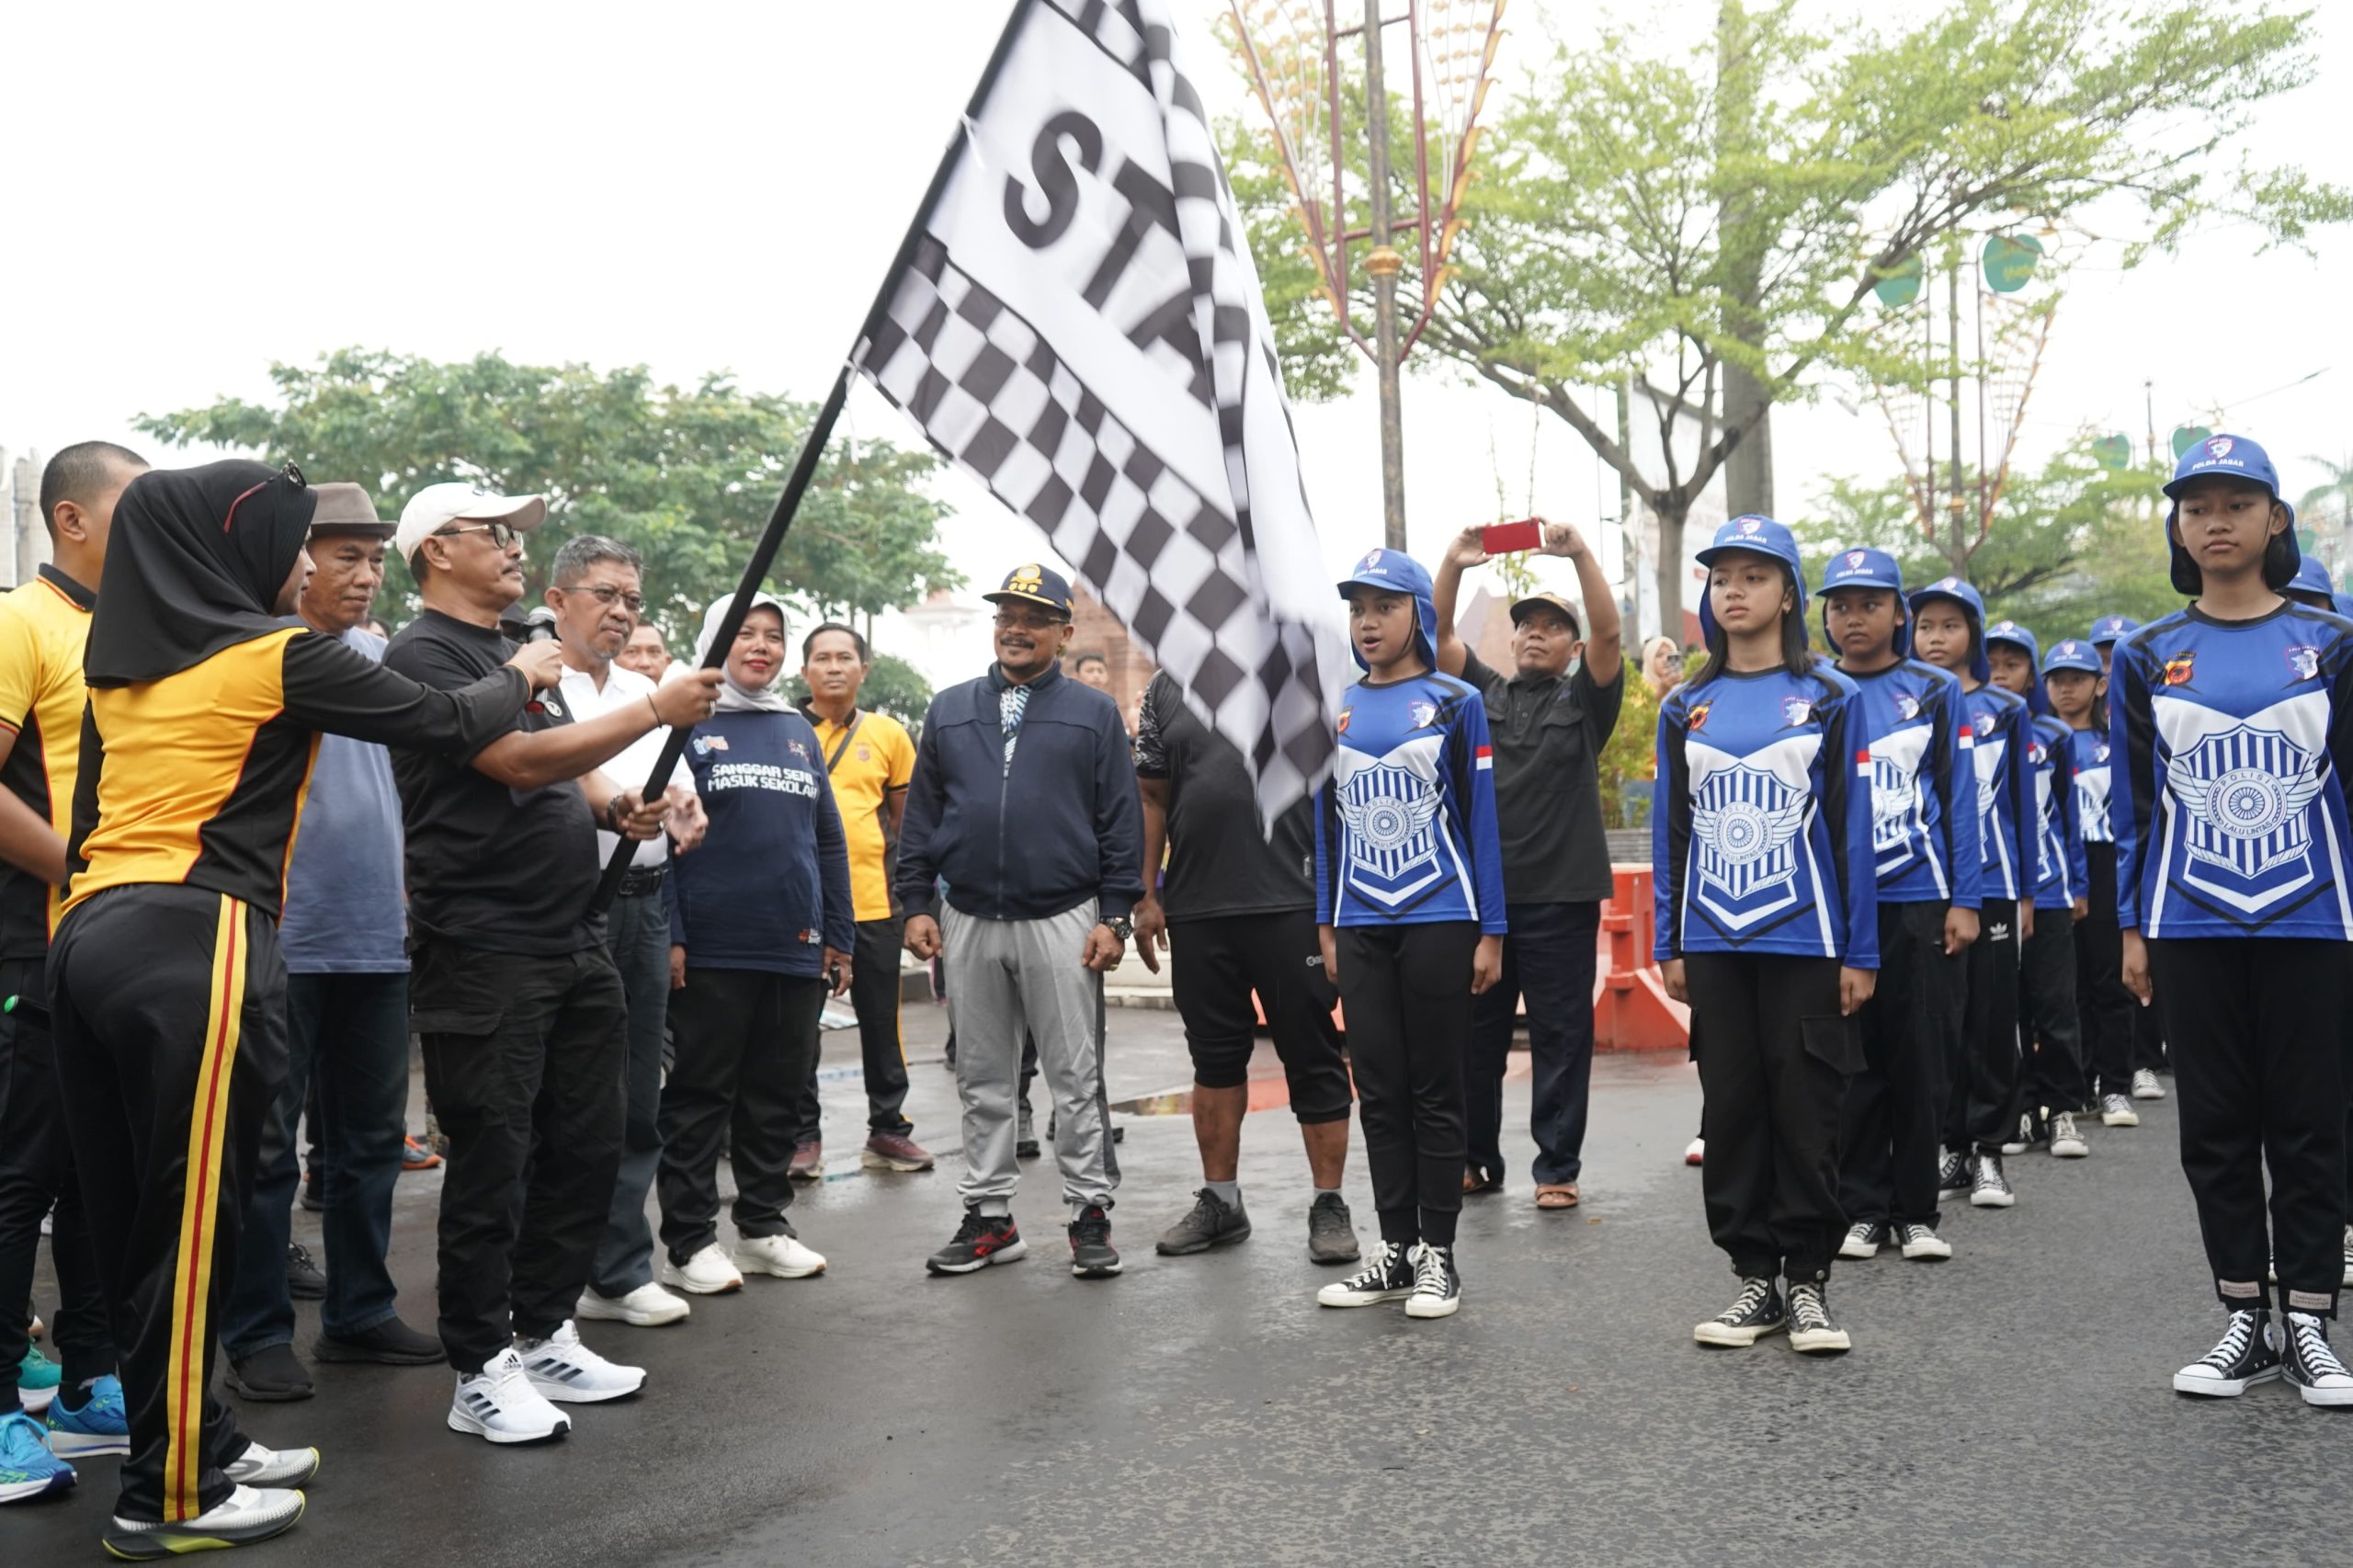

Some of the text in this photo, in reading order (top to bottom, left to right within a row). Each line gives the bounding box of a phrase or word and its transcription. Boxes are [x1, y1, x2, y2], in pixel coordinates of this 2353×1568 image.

[2192, 459, 2244, 471] POLDA JABAR
[711, 763, 782, 778] SANGGAR
[2221, 771, 2270, 786] POLISI
[708, 775, 817, 800] MASUK SEKOLAH
[1722, 805, 1759, 817] POLISI
[2224, 821, 2273, 835] LALU LINTAS
